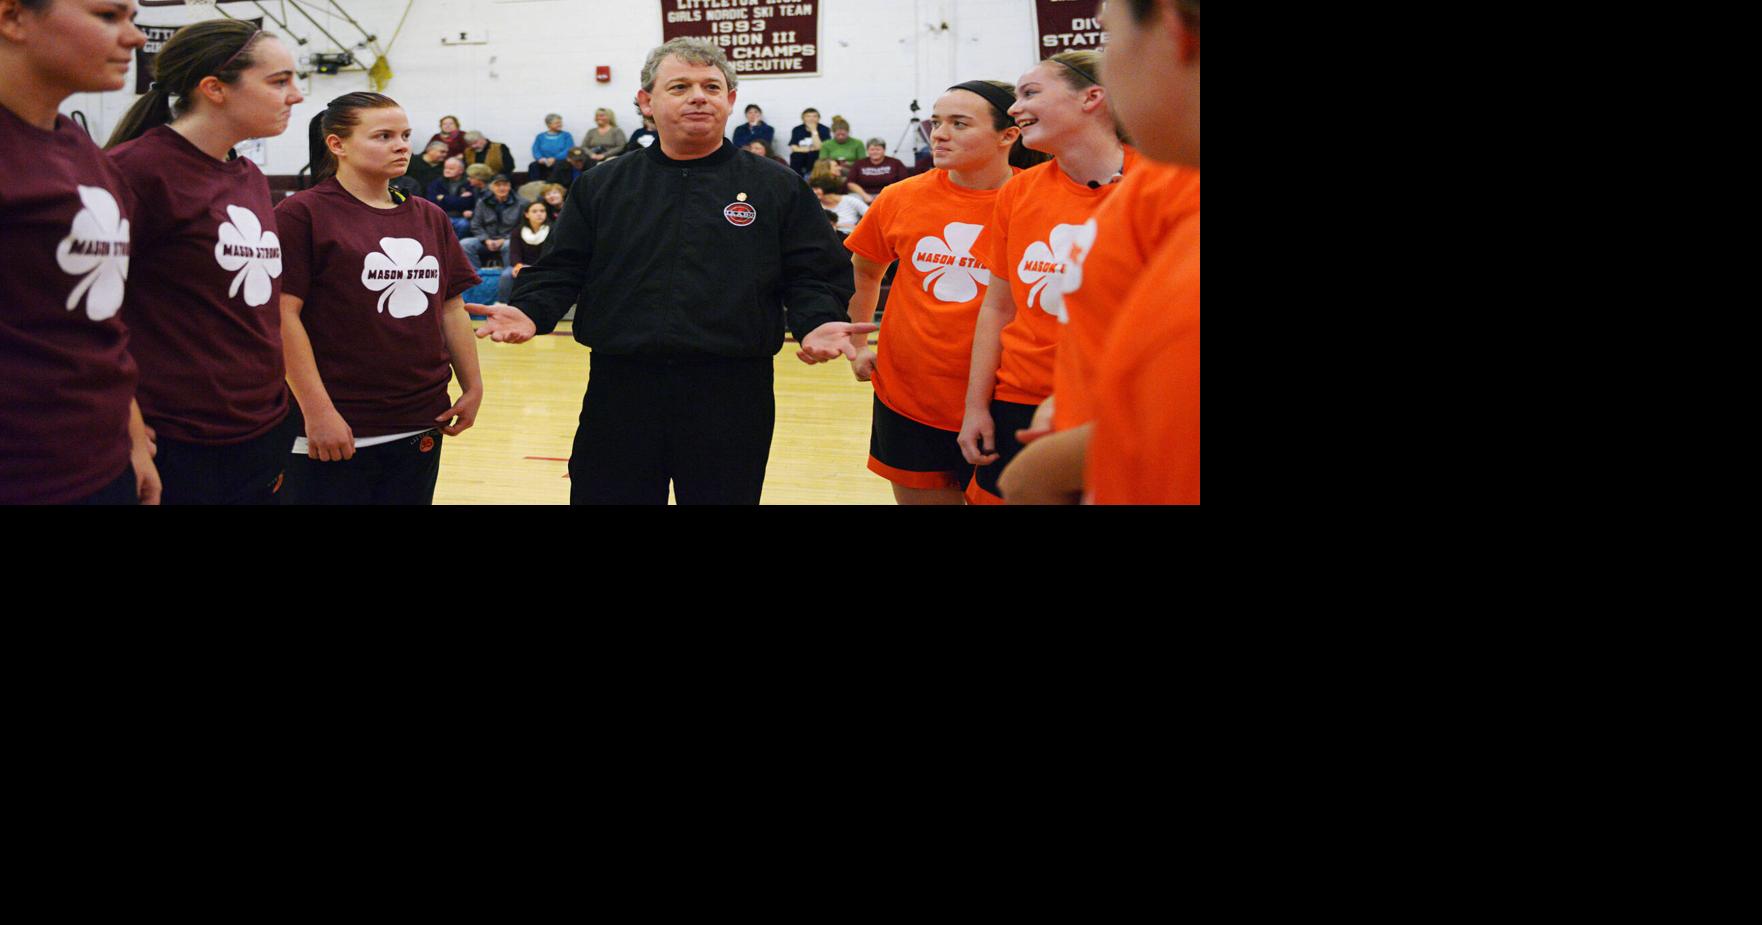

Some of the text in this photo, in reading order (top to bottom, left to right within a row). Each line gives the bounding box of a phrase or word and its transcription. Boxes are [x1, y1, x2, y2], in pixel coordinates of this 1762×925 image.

[667, 4, 813, 23] GIRLS NORDIC SKI TEAM
[712, 20, 766, 34] 1993
[772, 31, 797, 44] III
[1042, 32, 1111, 47] STATE
[732, 44, 816, 59] CHAMPS
[917, 251, 956, 266] MASON
[1024, 260, 1057, 273] MASON
[367, 269, 404, 280] MASON
